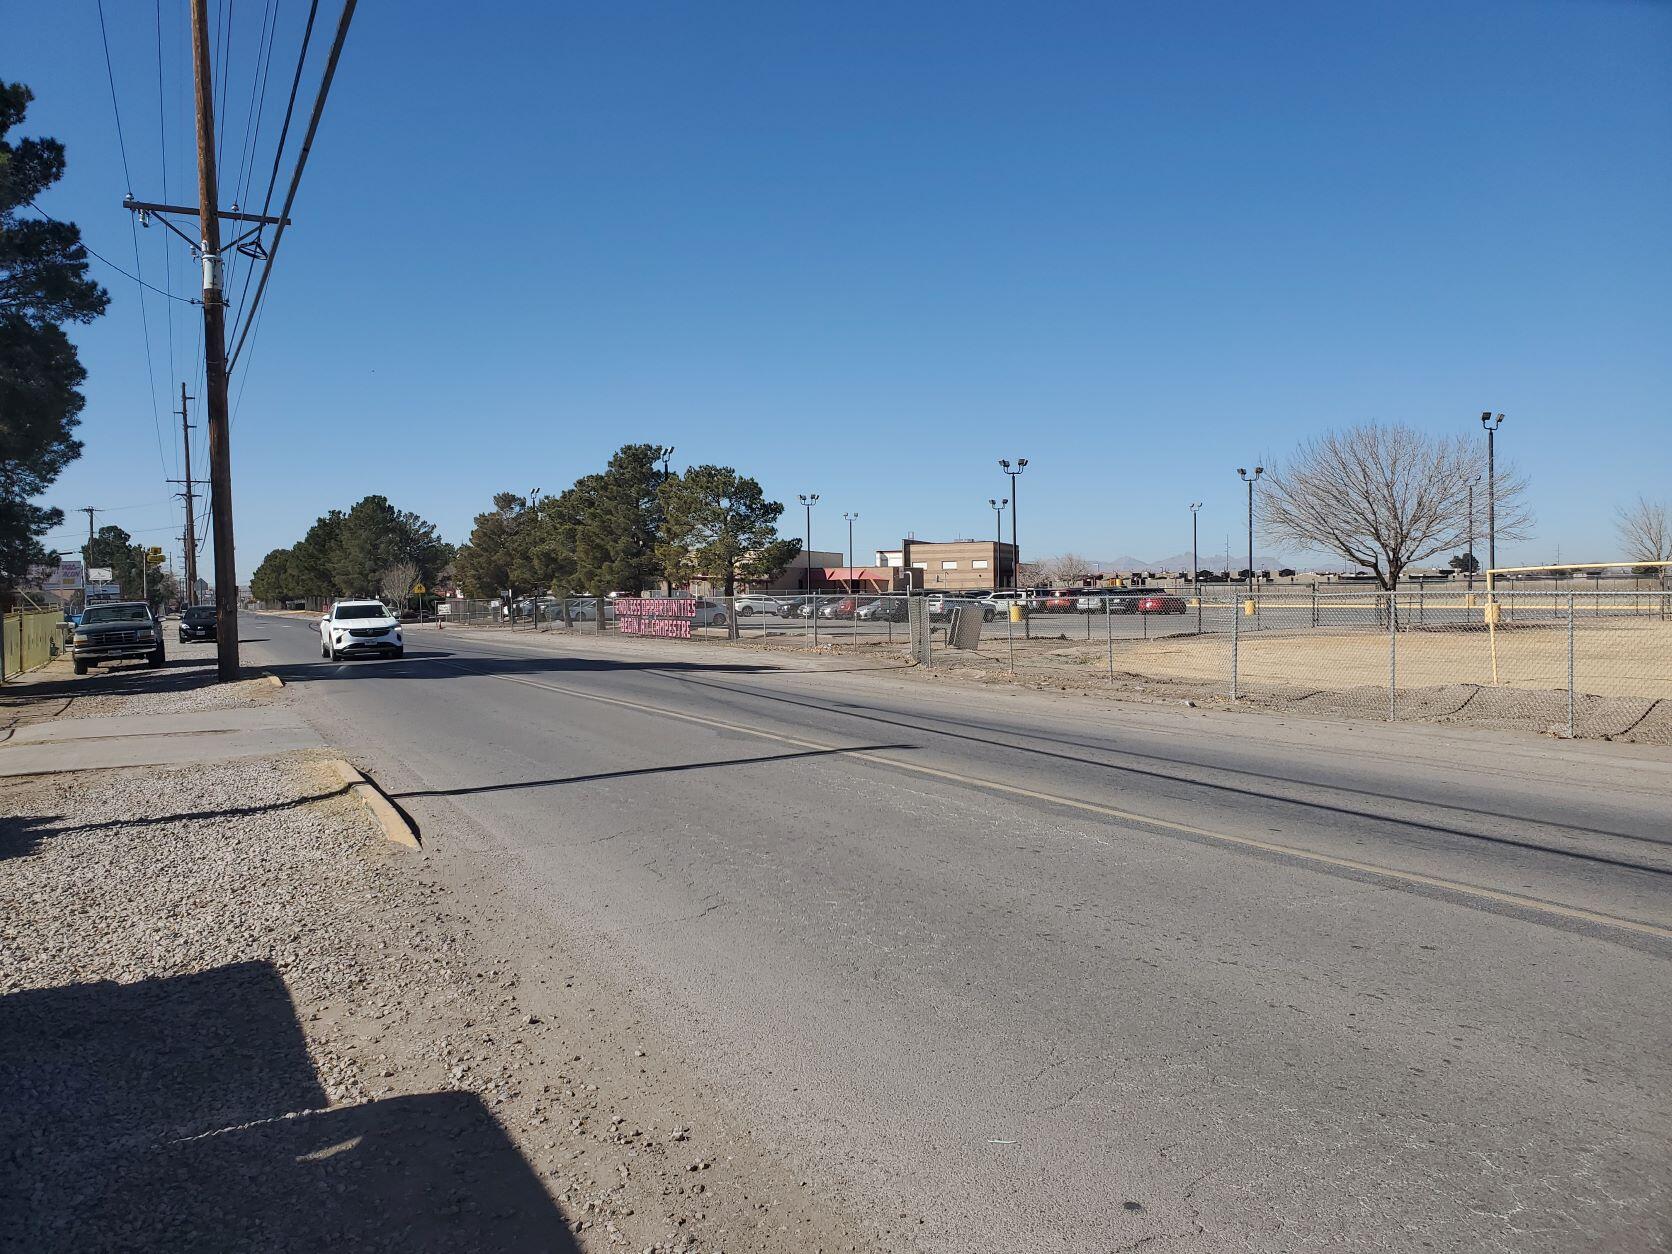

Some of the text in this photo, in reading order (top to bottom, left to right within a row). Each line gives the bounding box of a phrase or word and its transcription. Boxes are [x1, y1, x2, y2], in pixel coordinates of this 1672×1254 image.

[615, 599, 696, 617] ENDLESS OPPORTUNITIES
[620, 617, 691, 638] BEGIN AT CAMPESTRE
